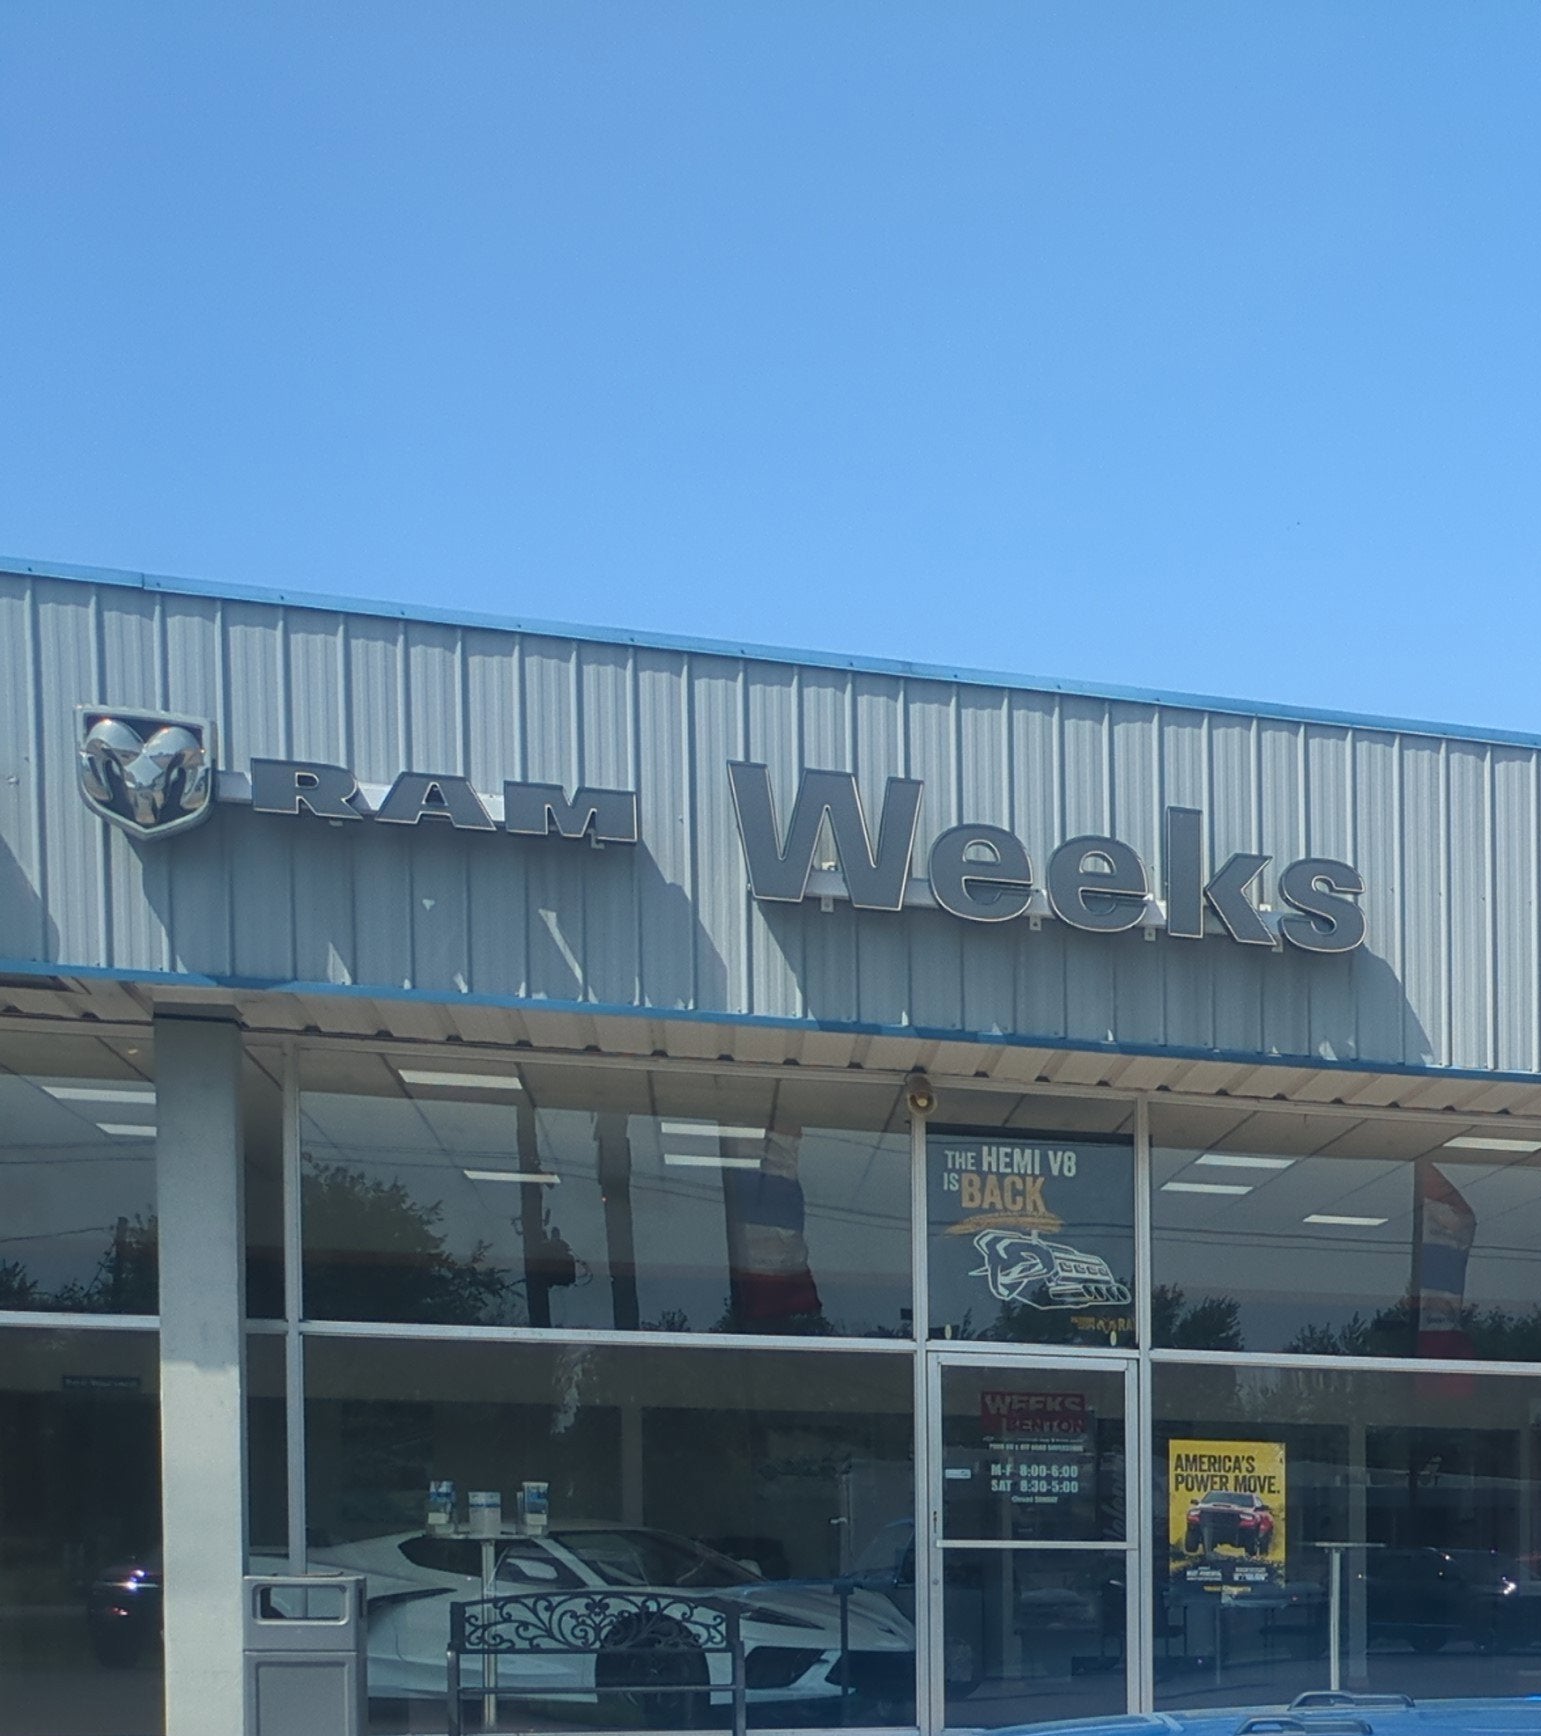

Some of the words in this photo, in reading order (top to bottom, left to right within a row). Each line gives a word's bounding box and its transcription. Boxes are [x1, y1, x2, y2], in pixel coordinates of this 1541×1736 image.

[251, 757, 638, 844] RAM
[726, 759, 1368, 954] Weeks
[944, 1150, 976, 1170] THE
[982, 1145, 1040, 1175] HEMI
[1048, 1150, 1077, 1177] V8
[943, 1171, 959, 1191] IS
[961, 1172, 1046, 1215] BACK
[991, 1464, 1012, 1476] M-F
[1020, 1464, 1079, 1477] 8:00-6:00
[1174, 1454, 1256, 1474] AMERICA'S
[991, 1480, 1012, 1492] SAT
[1020, 1480, 1079, 1493] 8:30-5:00
[1175, 1474, 1229, 1492] POWER
[1234, 1475, 1281, 1494] MOVE.
